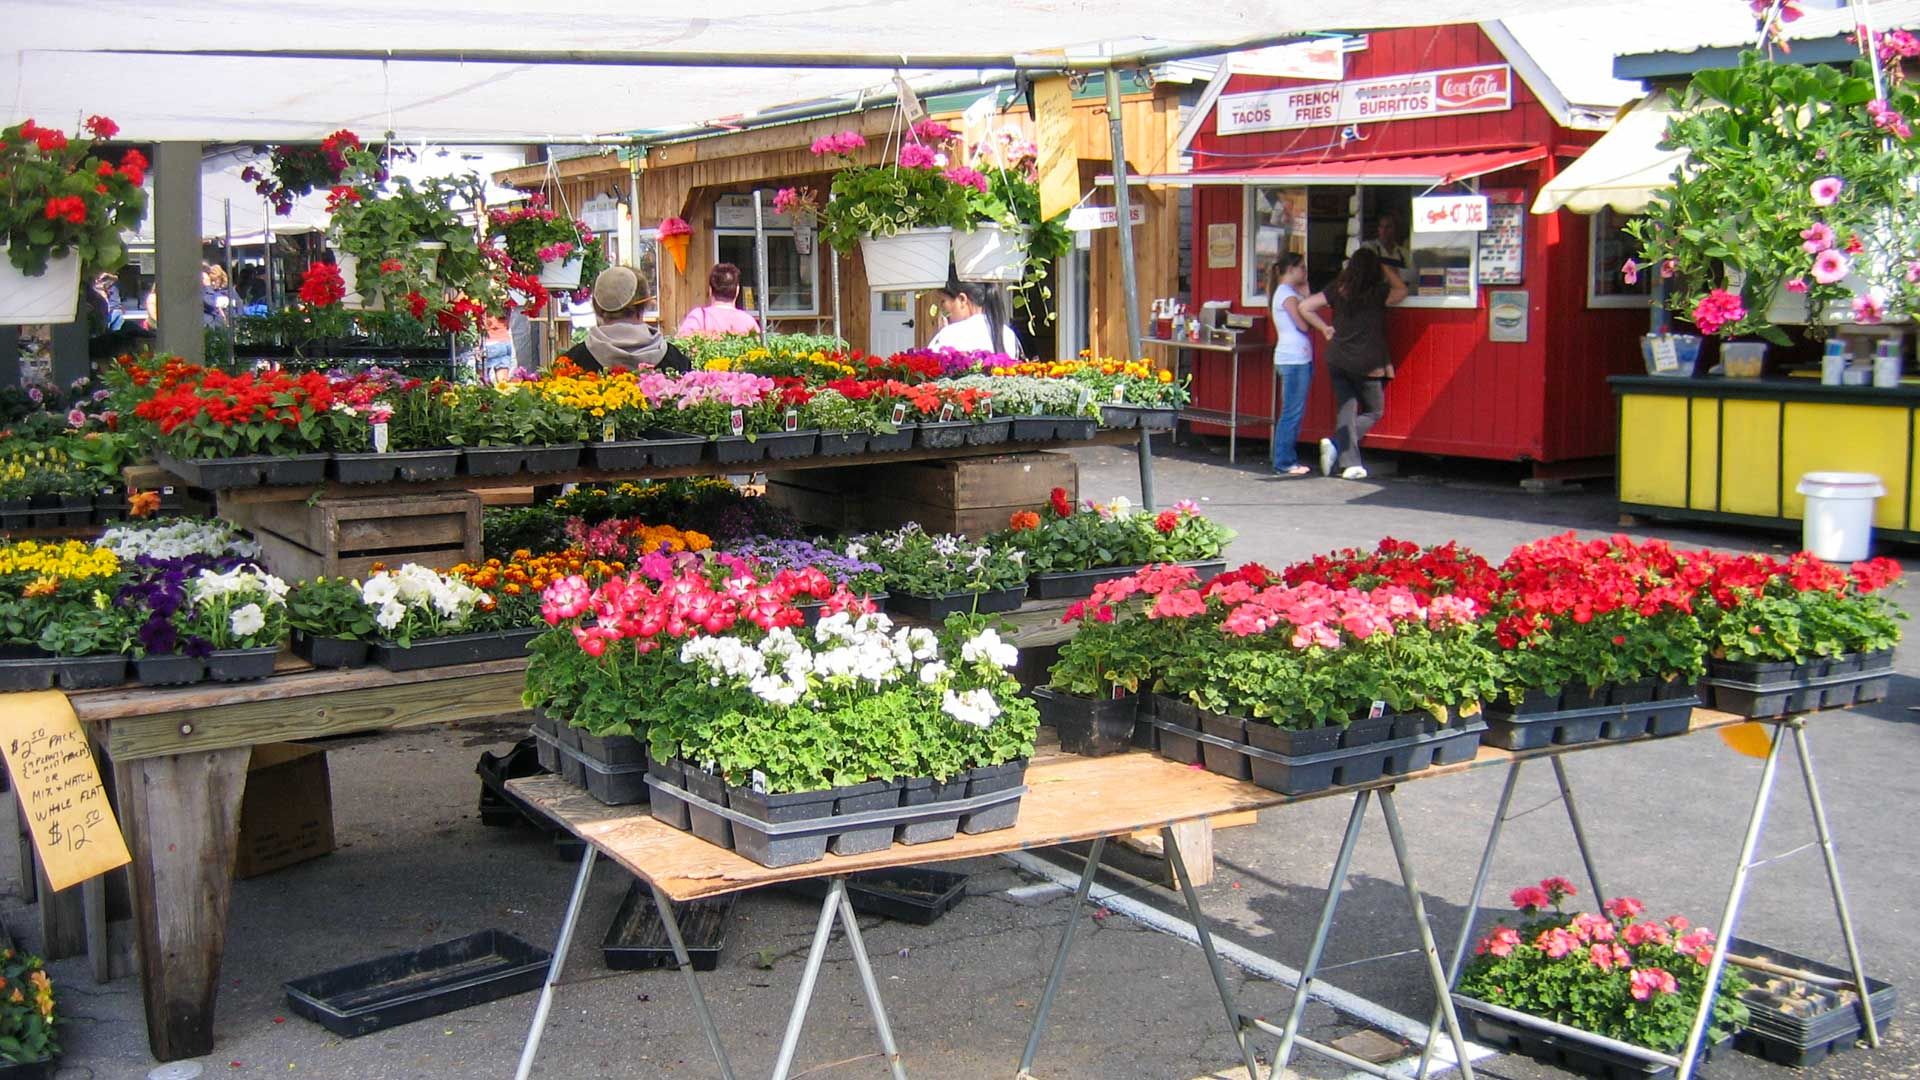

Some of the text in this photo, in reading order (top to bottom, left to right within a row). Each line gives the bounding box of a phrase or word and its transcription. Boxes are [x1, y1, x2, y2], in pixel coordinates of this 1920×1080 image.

[1442, 74, 1498, 97] Coca-Cola
[1289, 91, 1339, 107] FRENCH
[1360, 96, 1429, 115] BURRITOS
[1232, 109, 1271, 125] TACOS
[1295, 106, 1332, 121] FRIES
[46, 773, 59, 783] OR
[33, 787, 54, 803] MIX
[64, 771, 93, 790] MATCH
[80, 784, 104, 803] FLAT
